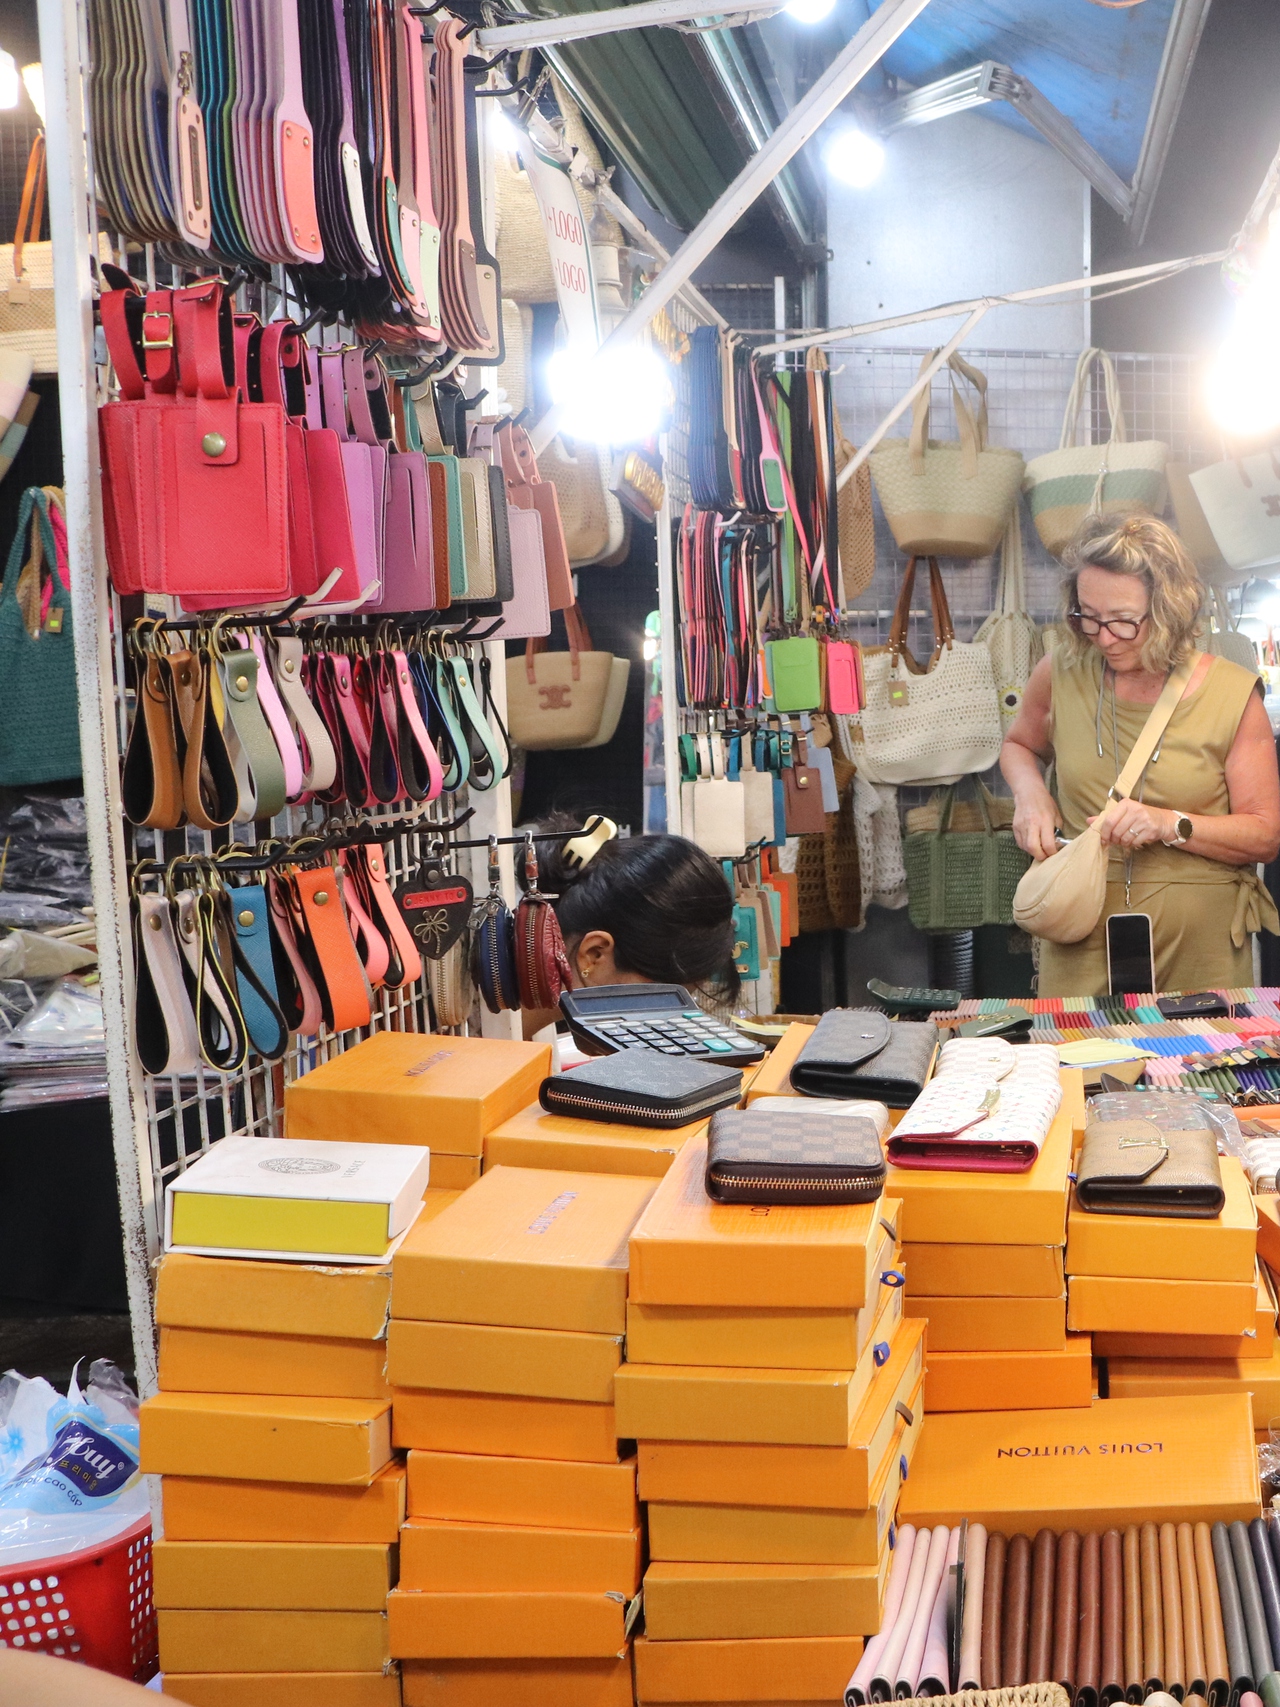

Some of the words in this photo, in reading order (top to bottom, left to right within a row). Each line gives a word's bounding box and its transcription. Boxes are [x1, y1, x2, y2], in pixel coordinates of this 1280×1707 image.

[997, 1444, 1092, 1459] VUITTON
[1098, 1441, 1164, 1455] LOUIS
[44, 1476, 67, 1491] cao
